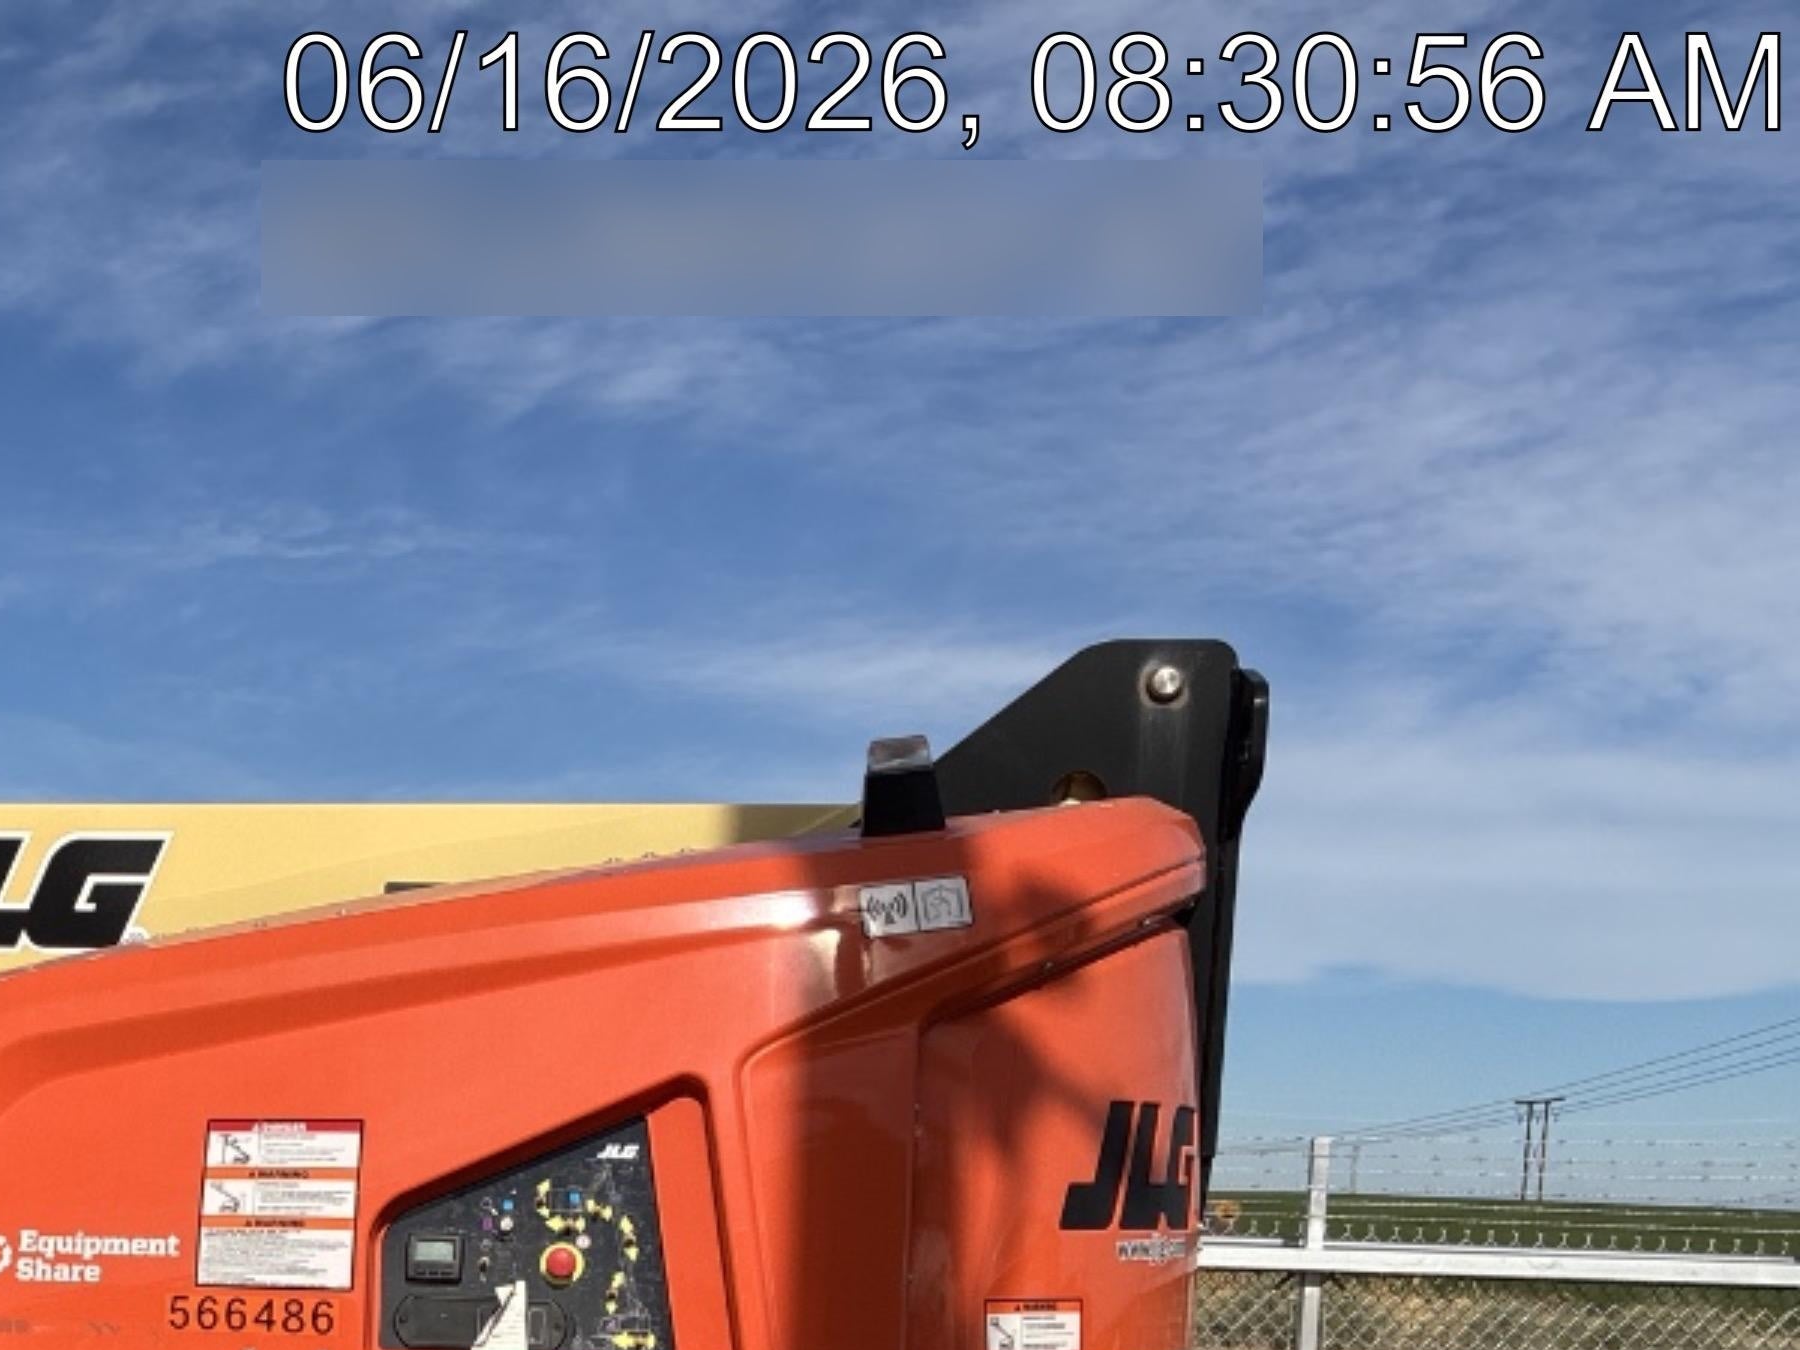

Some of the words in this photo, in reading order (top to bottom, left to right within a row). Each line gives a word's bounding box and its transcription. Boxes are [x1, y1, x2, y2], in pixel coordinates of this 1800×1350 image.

[595, 1143, 640, 1160] JLG
[1058, 1099, 1197, 1231] JLG
[18, 1228, 181, 1260] Equipment
[14, 1256, 102, 1283] Share
[168, 1295, 336, 1336] 566486
